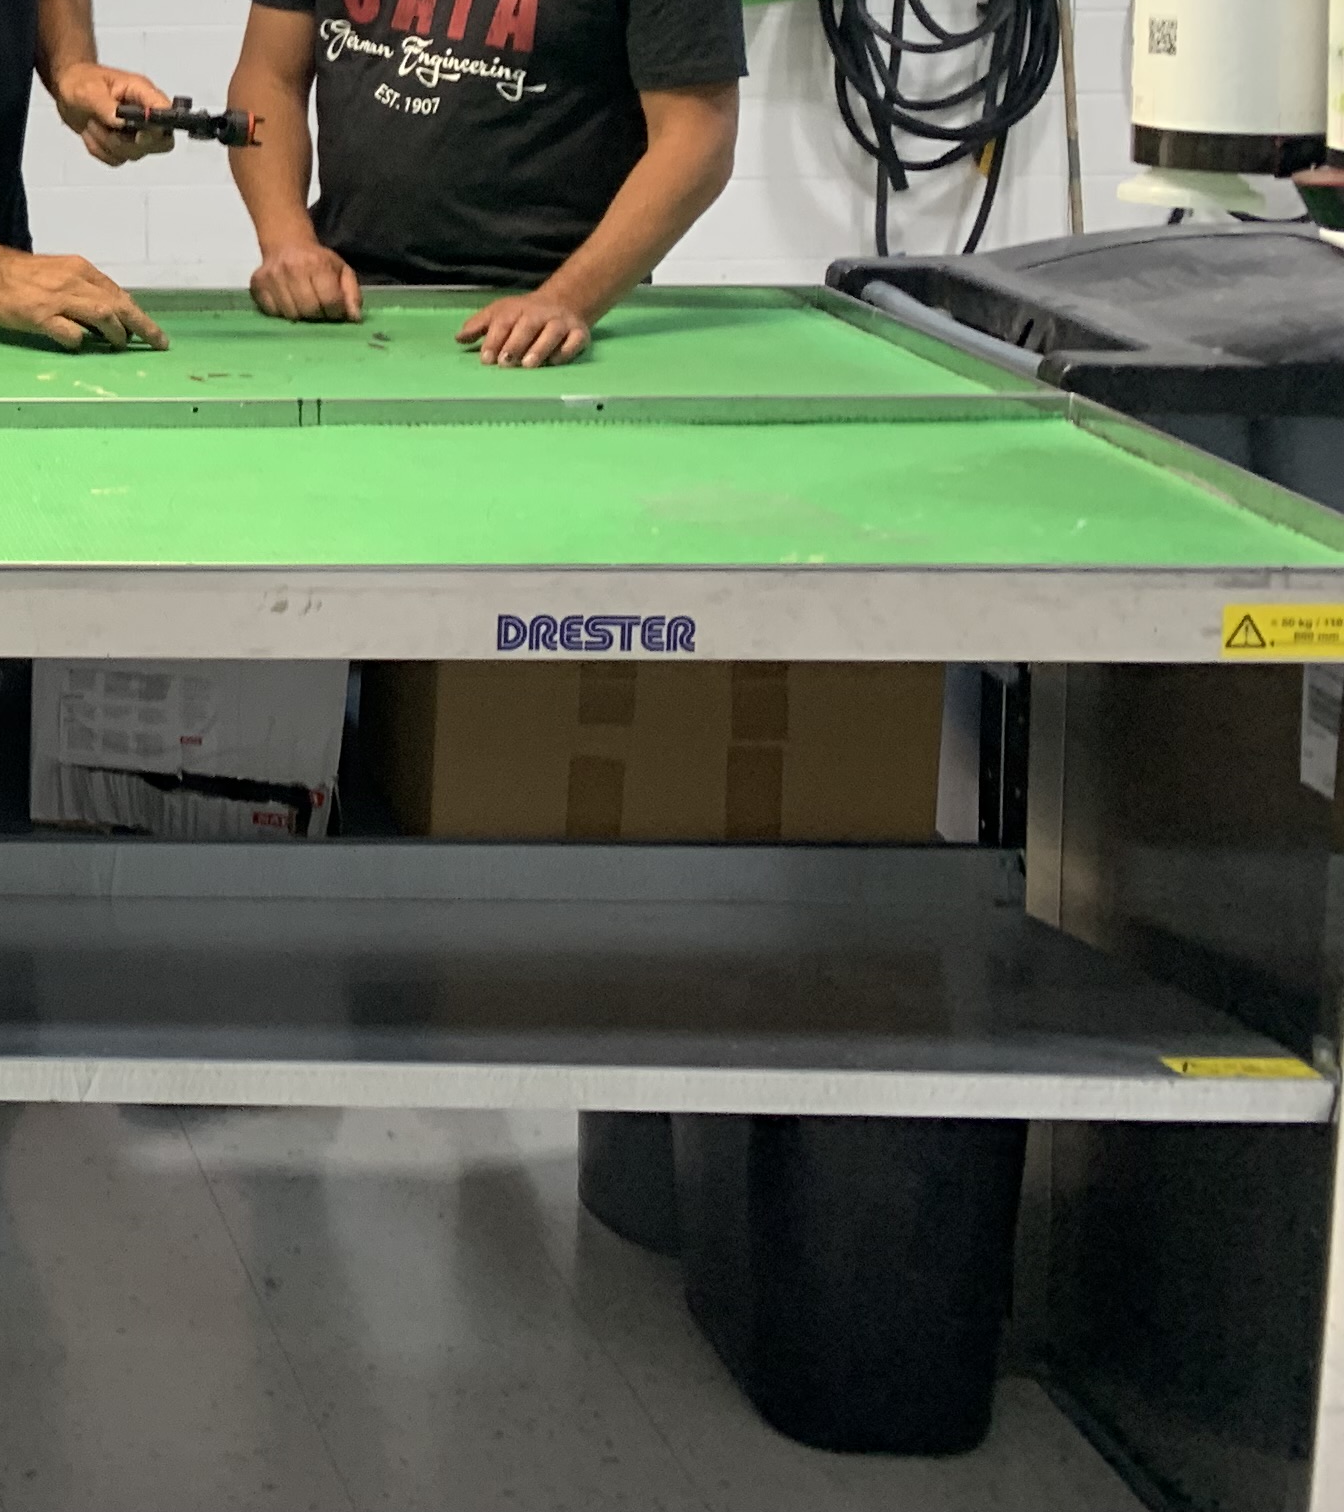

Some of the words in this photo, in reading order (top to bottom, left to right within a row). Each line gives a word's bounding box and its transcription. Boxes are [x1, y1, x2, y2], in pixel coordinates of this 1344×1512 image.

[320, 19, 394, 62] German
[398, 35, 547, 102] Engineering
[374, 83, 400, 110] EST.
[405, 96, 441, 114] 1907
[497, 614, 696, 652] DRESTER
